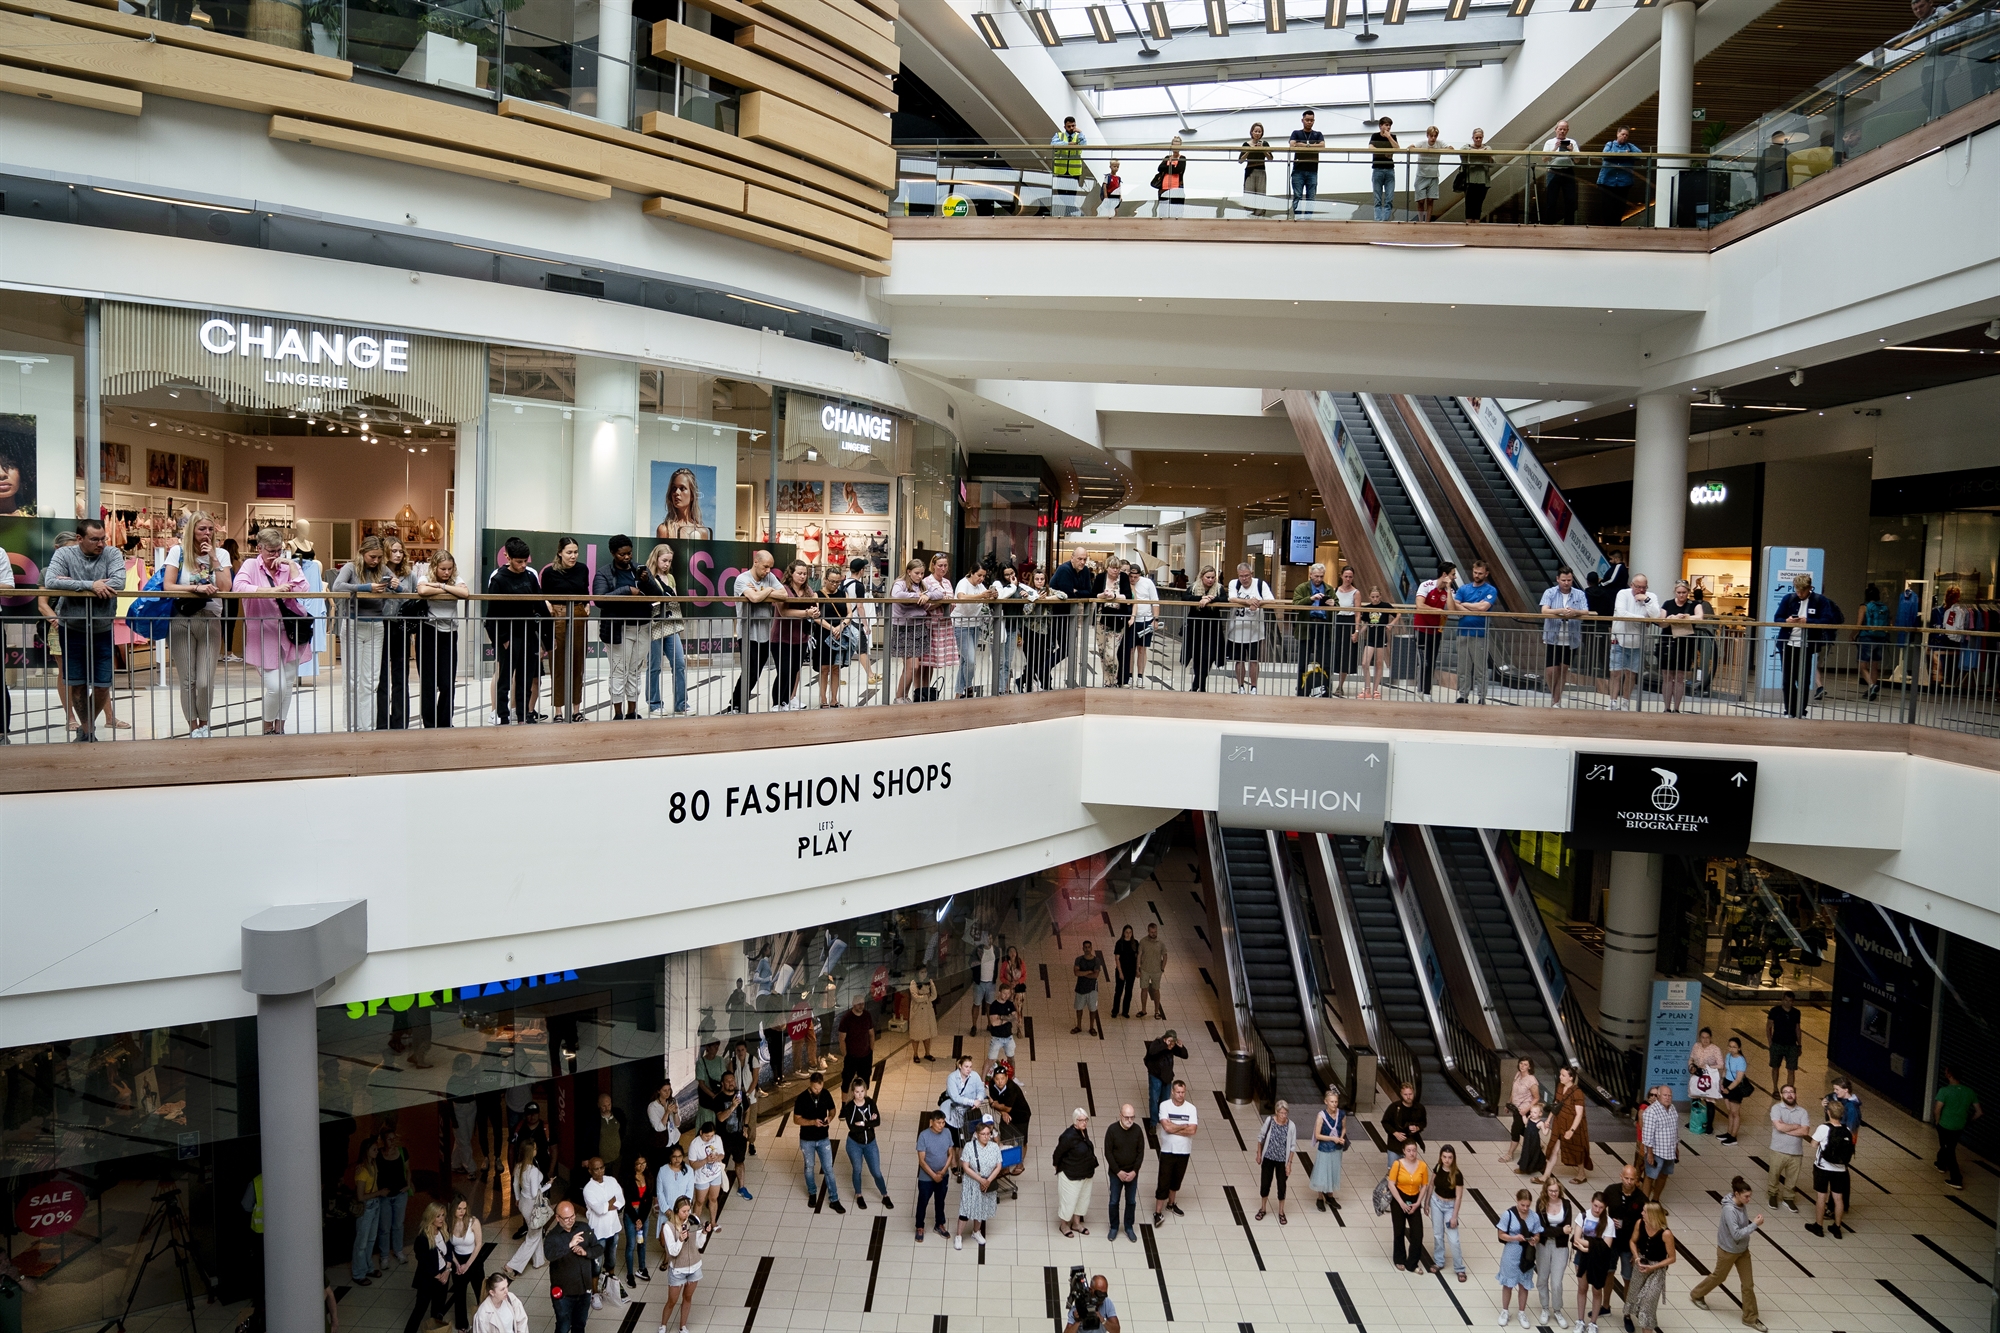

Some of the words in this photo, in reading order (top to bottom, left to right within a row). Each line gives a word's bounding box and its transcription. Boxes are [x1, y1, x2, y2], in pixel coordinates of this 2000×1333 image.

[199, 318, 410, 373] CHANGE
[264, 369, 349, 390] LINGERIE
[821, 405, 892, 442] CHANGE
[841, 441, 871, 454] LINGERIE
[1063, 515, 1083, 528] H&M
[700, 641, 722, 652] 50%
[1248, 747, 1254, 762] 1
[1608, 766, 1614, 781] 1
[668, 789, 711, 824] 80
[726, 773, 860, 817] FASHION
[872, 760, 952, 799] SHOPS
[1242, 785, 1361, 812] FASHION
[818, 820, 834, 831] LET'S
[1617, 811, 1675, 822] NORDISK
[1677, 814, 1709, 824] FILM
[1626, 820, 1698, 832] BIOGRAFER
[798, 829, 853, 859] PLAY
[1855, 932, 1913, 968] Nykredit
[1863, 982, 1897, 1003] KONTANTER
[792, 1007, 808, 1020] SALE
[792, 1020, 808, 1035] 70%
[29, 1190, 73, 1207] SALE
[29, 1209, 73, 1229] 70%
